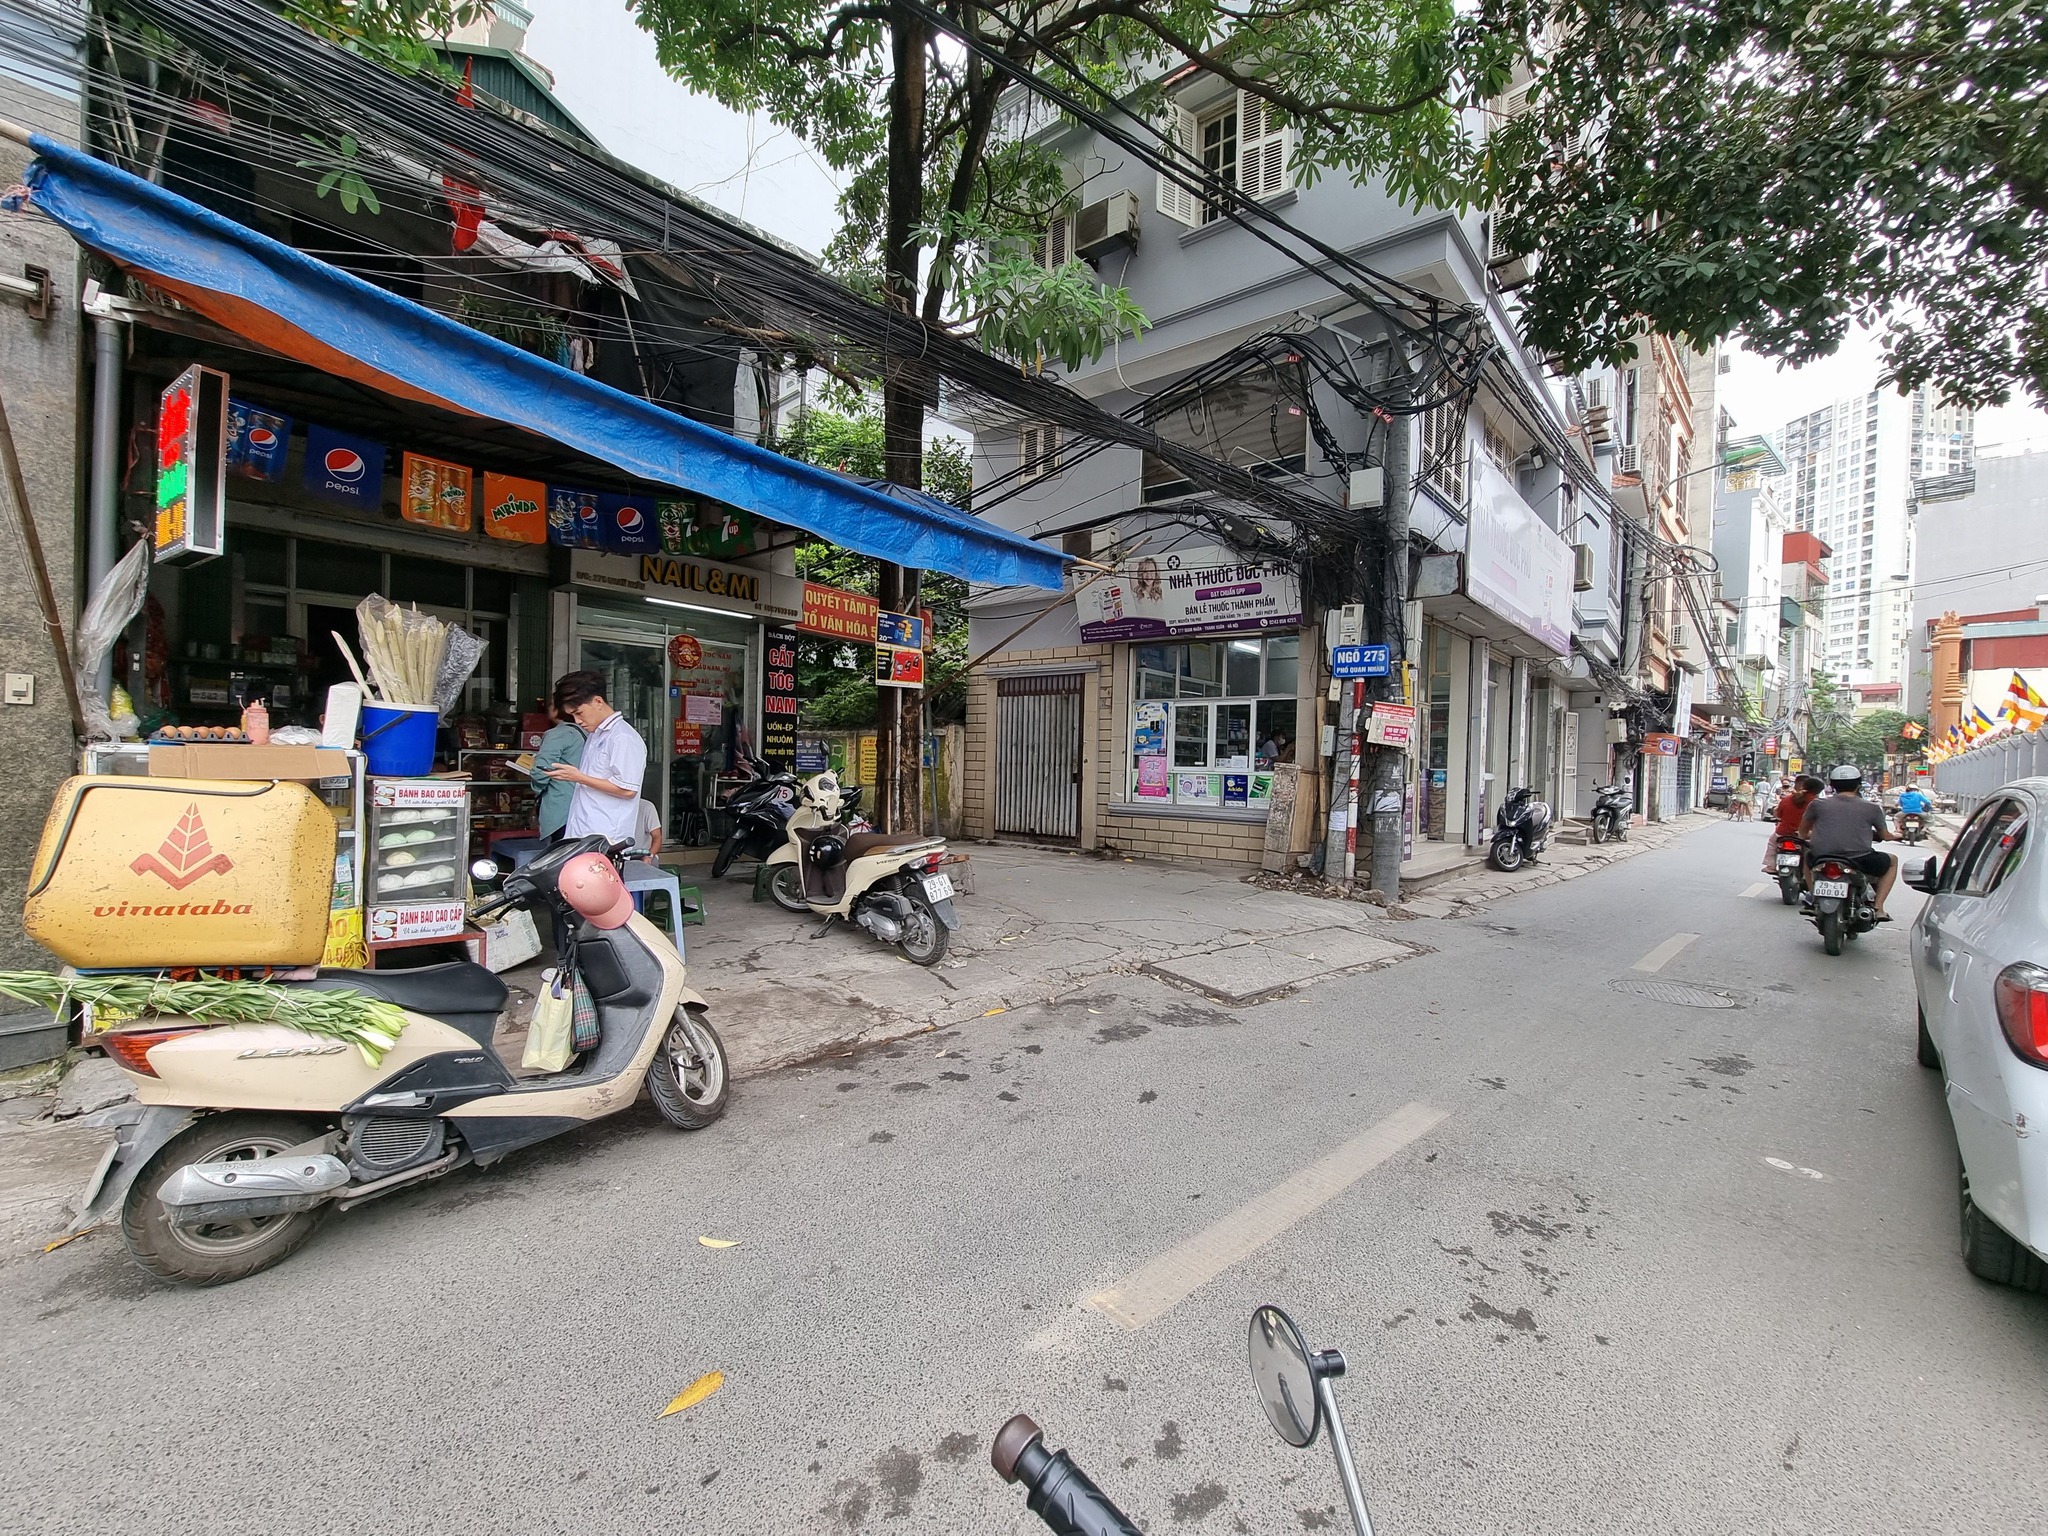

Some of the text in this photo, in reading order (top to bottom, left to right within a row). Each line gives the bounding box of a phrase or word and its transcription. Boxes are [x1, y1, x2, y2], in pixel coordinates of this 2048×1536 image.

[249, 448, 273, 459] pepsi
[325, 481, 360, 495] pepsi
[491, 500, 538, 521] MIRINDA
[621, 535, 644, 543] pepsi
[1169, 571, 1193, 590] NHÀ
[1195, 563, 1233, 586] THUỐC
[805, 589, 840, 610] QUYẾT
[843, 598, 866, 617] TÂM
[1185, 594, 1276, 616] BÁN LẺ THUỐC THÀNH PHẨM
[803, 609, 817, 627] TỔ
[820, 615, 843, 632] VĂN
[846, 619, 868, 637] HÓA
[768, 644, 795, 668] CẮT
[1337, 649, 1385, 664] NGÕ 275
[768, 670, 794, 691] TÓC
[765, 695, 797, 715] NAM
[399, 787, 418, 798] BÁNH
[421, 790, 435, 798] BAO
[437, 790, 450, 798] CAO
[1816, 889, 1845, 897] 000.04
[93, 900, 253, 918] vinataba
[400, 904, 462, 925] BÁNH BAO CAO CẤP
[237, 1045, 347, 1060] LEAD
